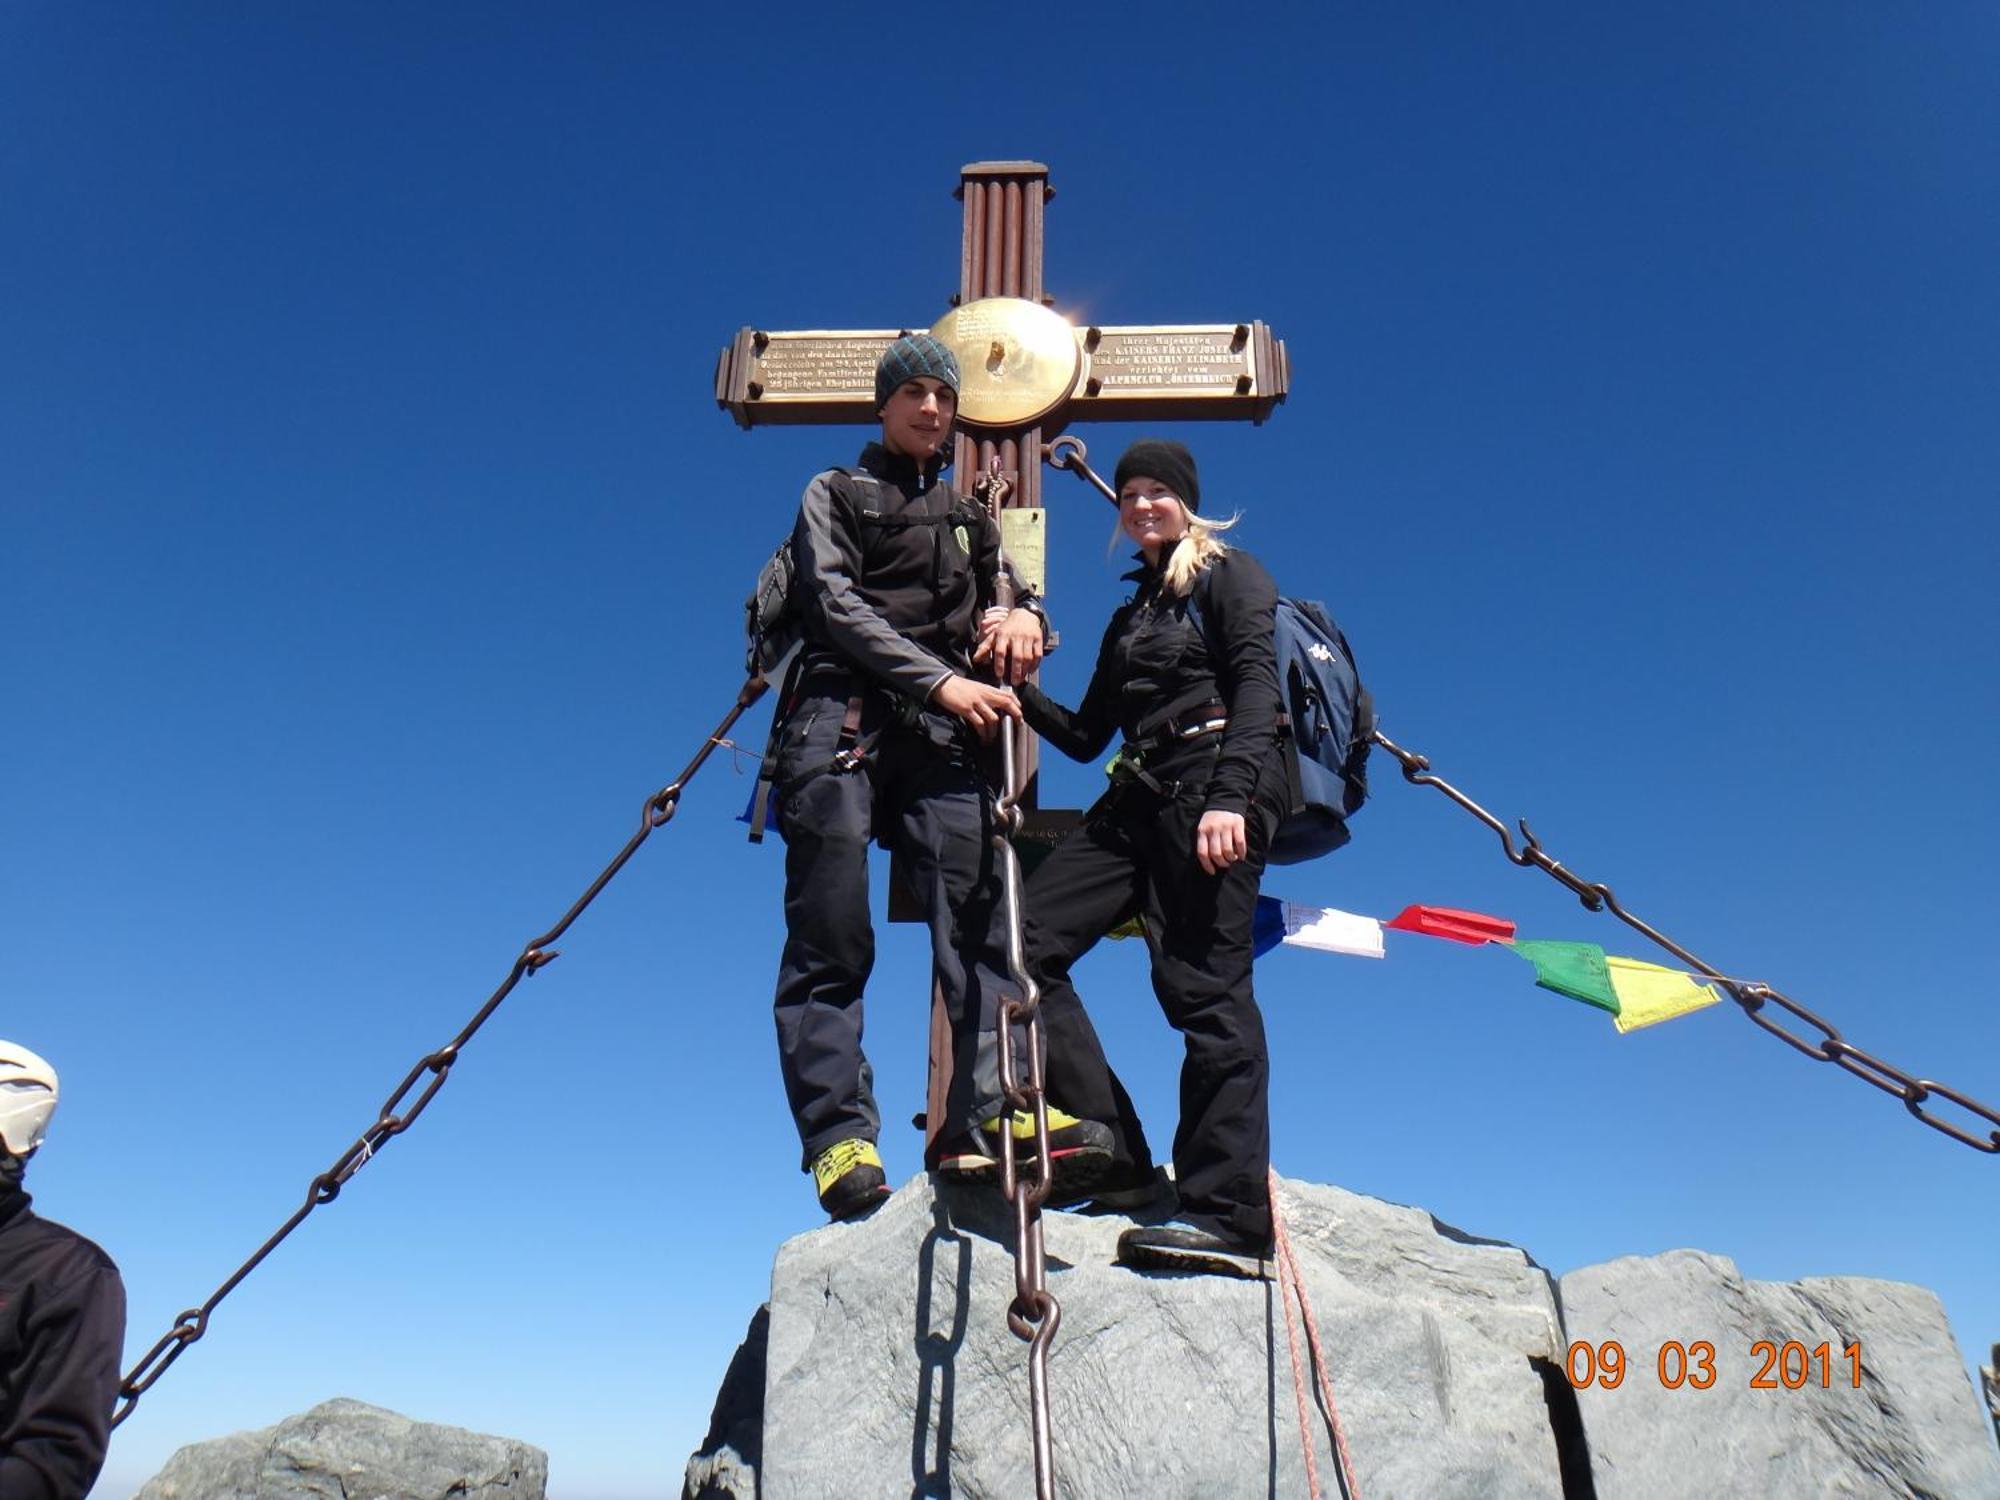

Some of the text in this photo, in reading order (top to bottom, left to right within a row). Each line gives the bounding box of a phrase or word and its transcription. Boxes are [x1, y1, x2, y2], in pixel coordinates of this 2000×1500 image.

[1115, 346, 1158, 355] KAISERS
[1162, 345, 1195, 355] FRANZ
[1133, 355, 1183, 365] KAISERIN
[1186, 354, 1243, 364] ELISABETH
[1103, 375, 1162, 385] ALPENCLUB
